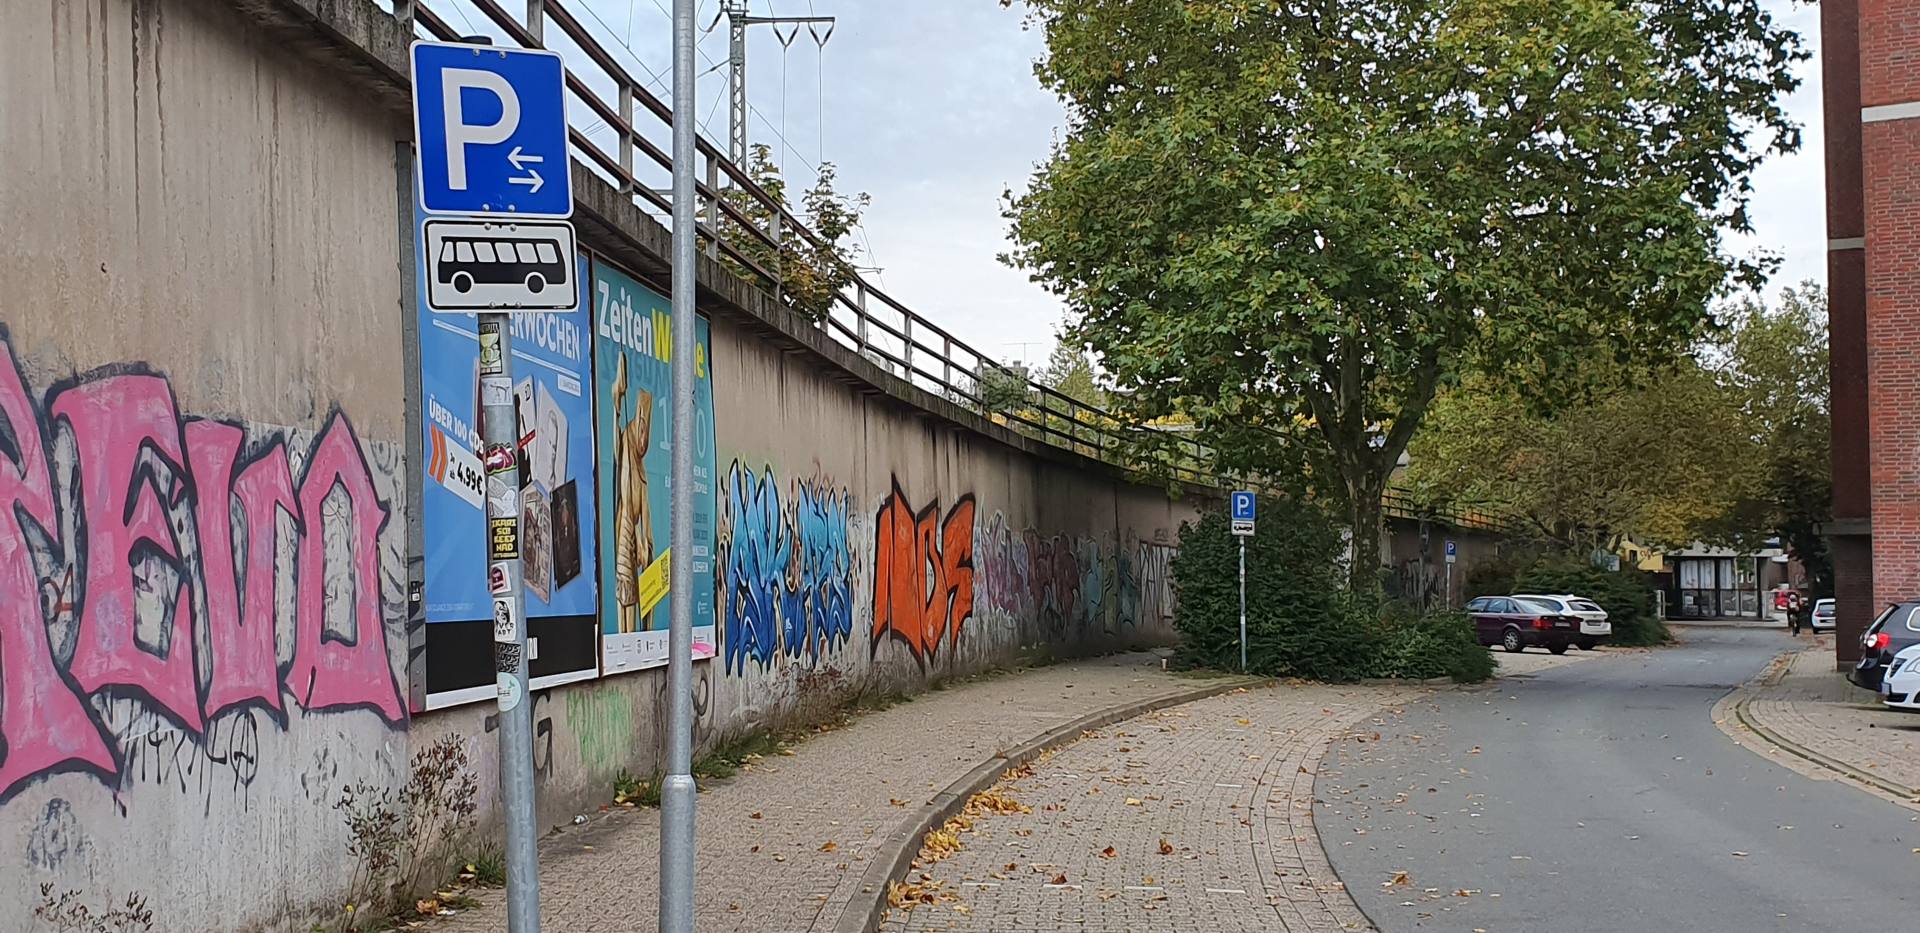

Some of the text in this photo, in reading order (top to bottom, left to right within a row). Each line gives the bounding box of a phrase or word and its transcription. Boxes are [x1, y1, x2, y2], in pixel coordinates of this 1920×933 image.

[441, 66, 521, 191] P
[429, 393, 453, 433] ÜBER
[454, 415, 468, 442] 100
[1237, 495, 1249, 516] P
[1448, 542, 1455, 553] P
